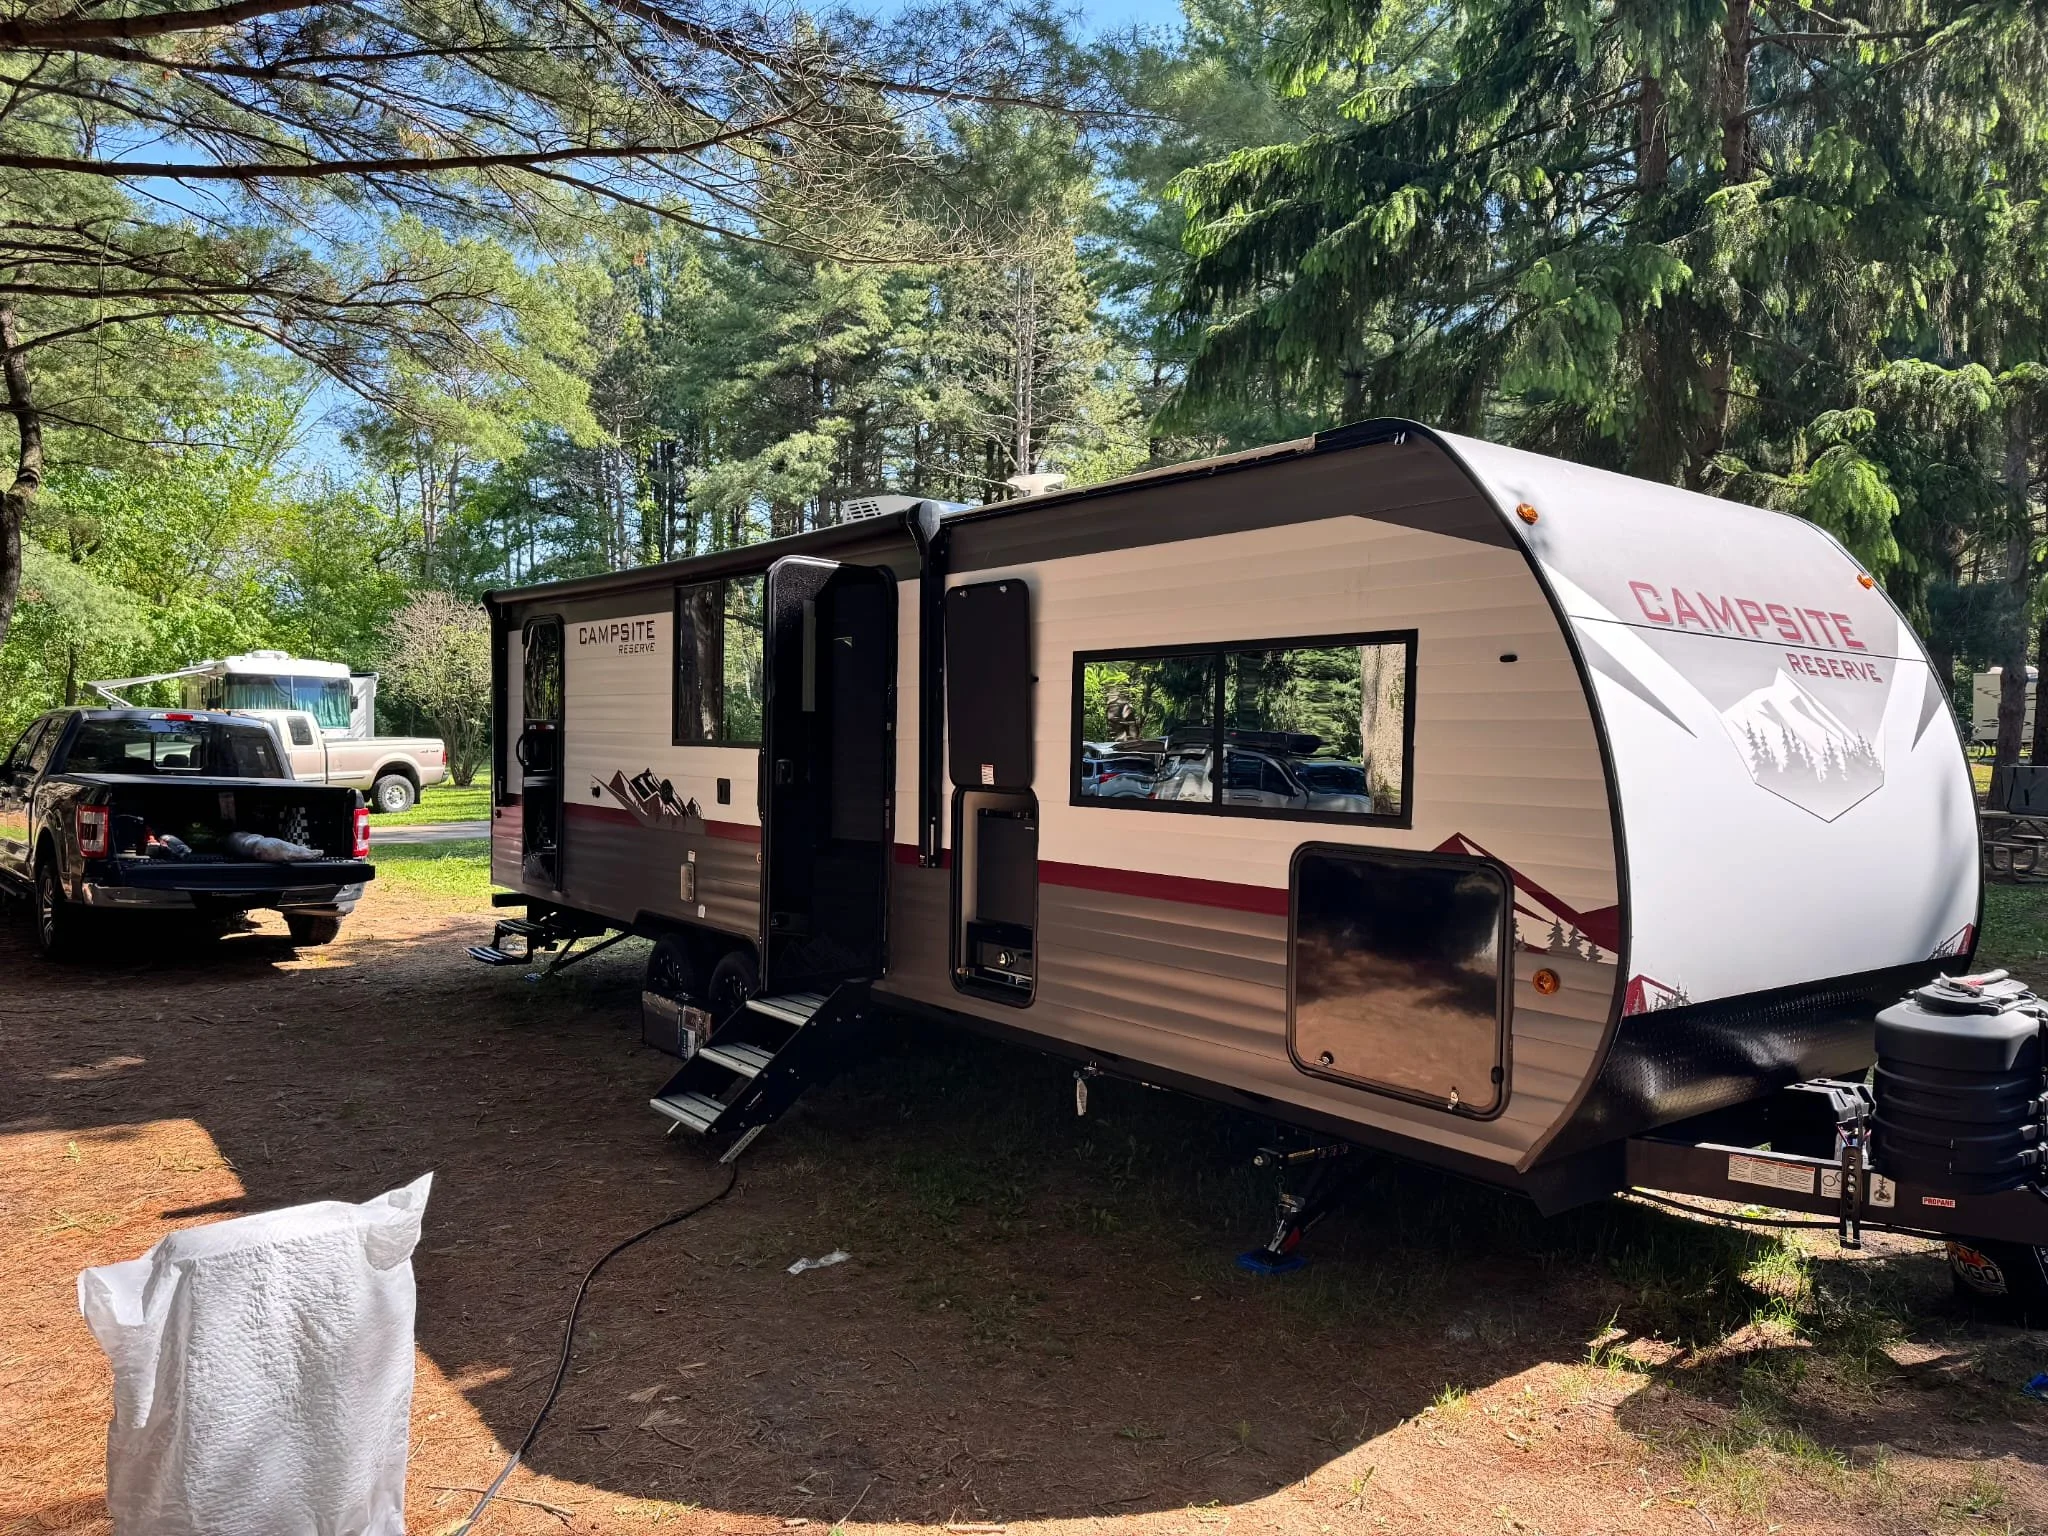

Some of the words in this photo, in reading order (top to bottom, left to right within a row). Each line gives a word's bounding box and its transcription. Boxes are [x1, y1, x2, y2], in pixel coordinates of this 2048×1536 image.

[1628, 581, 1868, 651] CAMPSITE
[579, 620, 655, 645] CAMPSITE
[619, 642, 655, 655] RESERVE
[1785, 652, 1883, 684] RESERVE
[1923, 1197, 1954, 1207] PROPANE
